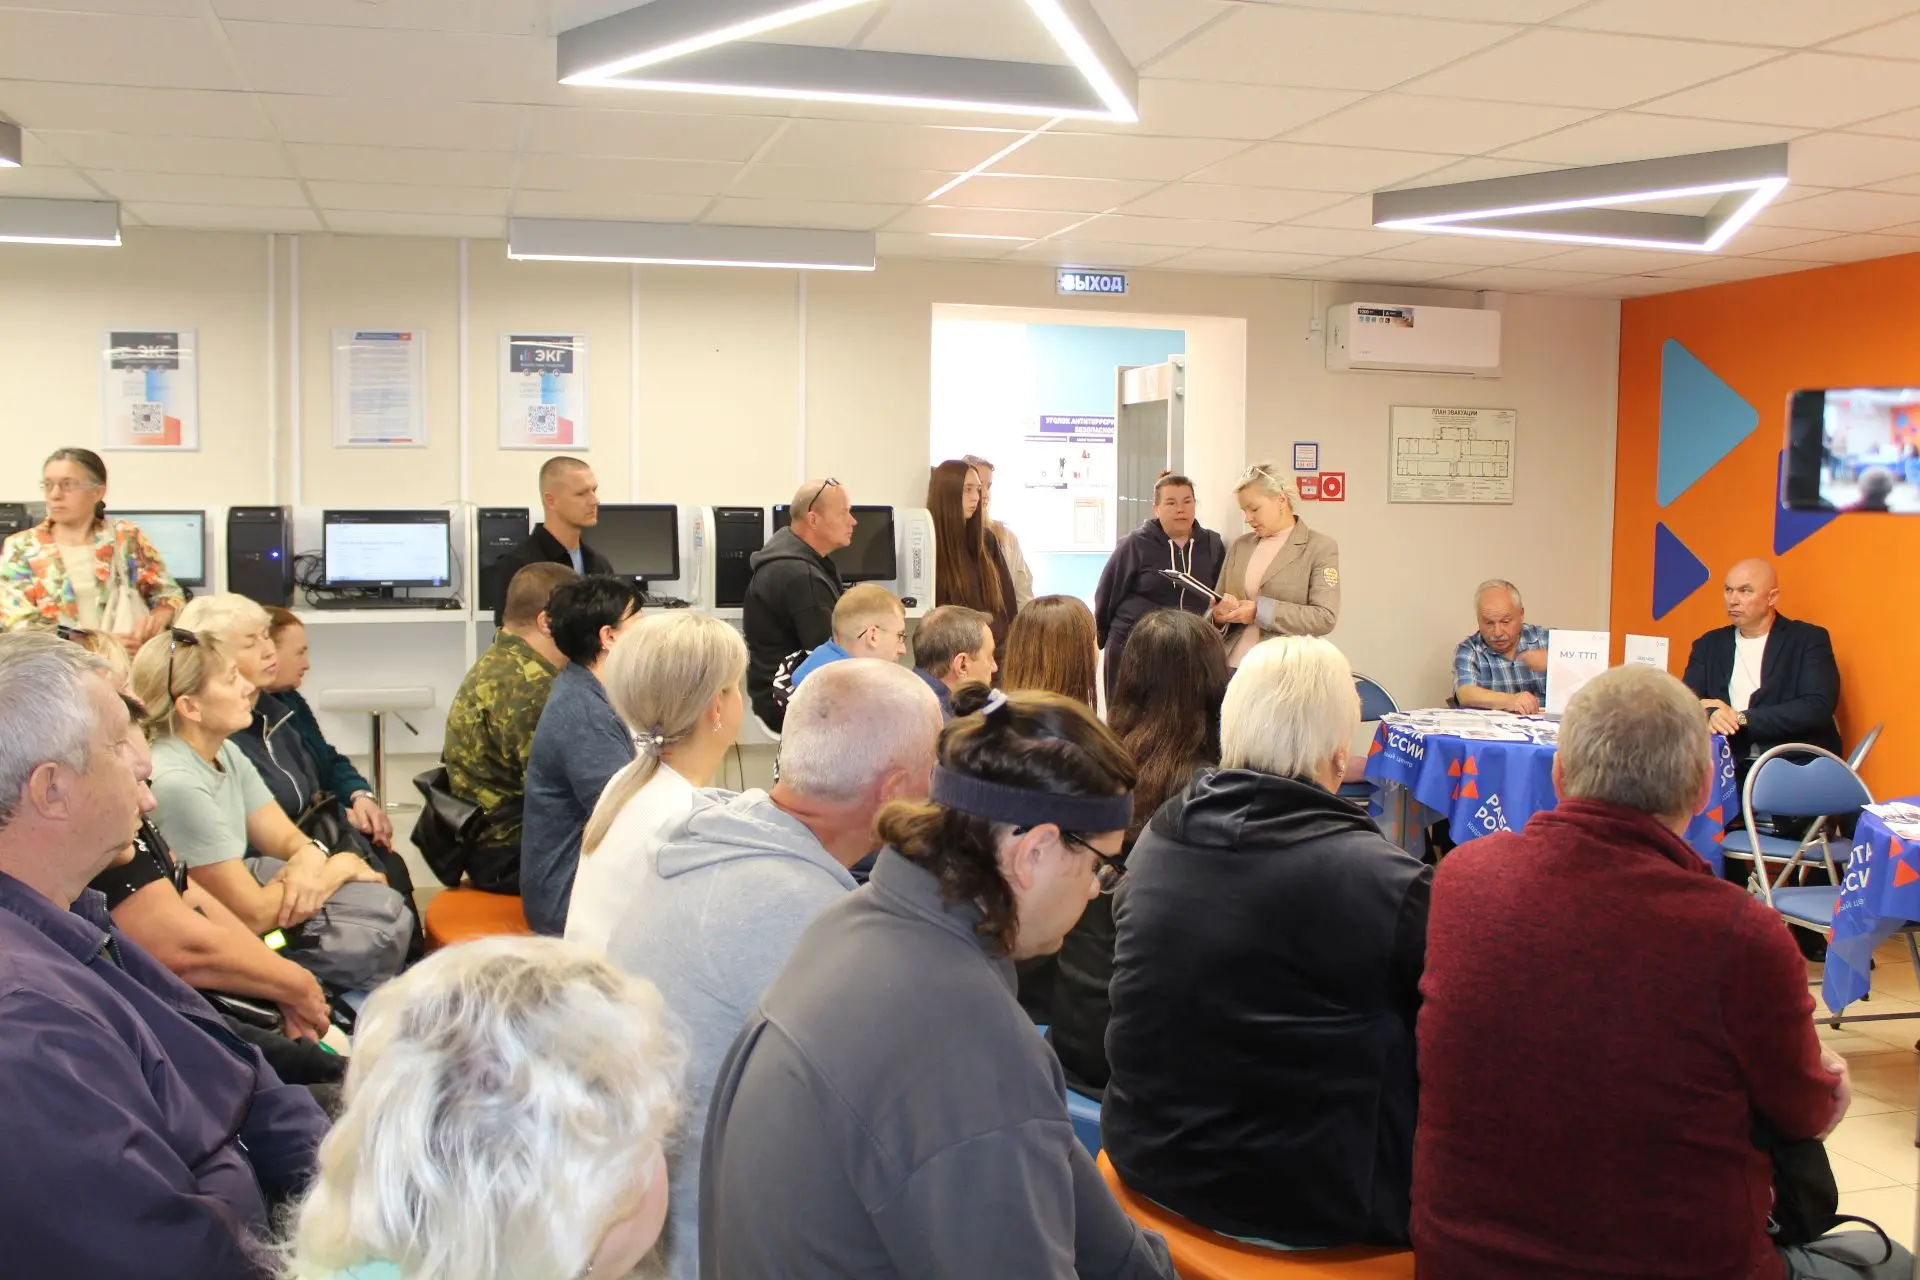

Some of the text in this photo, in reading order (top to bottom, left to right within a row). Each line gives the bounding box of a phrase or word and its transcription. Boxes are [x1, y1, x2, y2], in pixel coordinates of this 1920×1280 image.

[1063, 274, 1123, 292] ВЫХОД
[535, 349, 566, 362] ЭКГ
[1559, 650, 1598, 660] МУ ТТП
